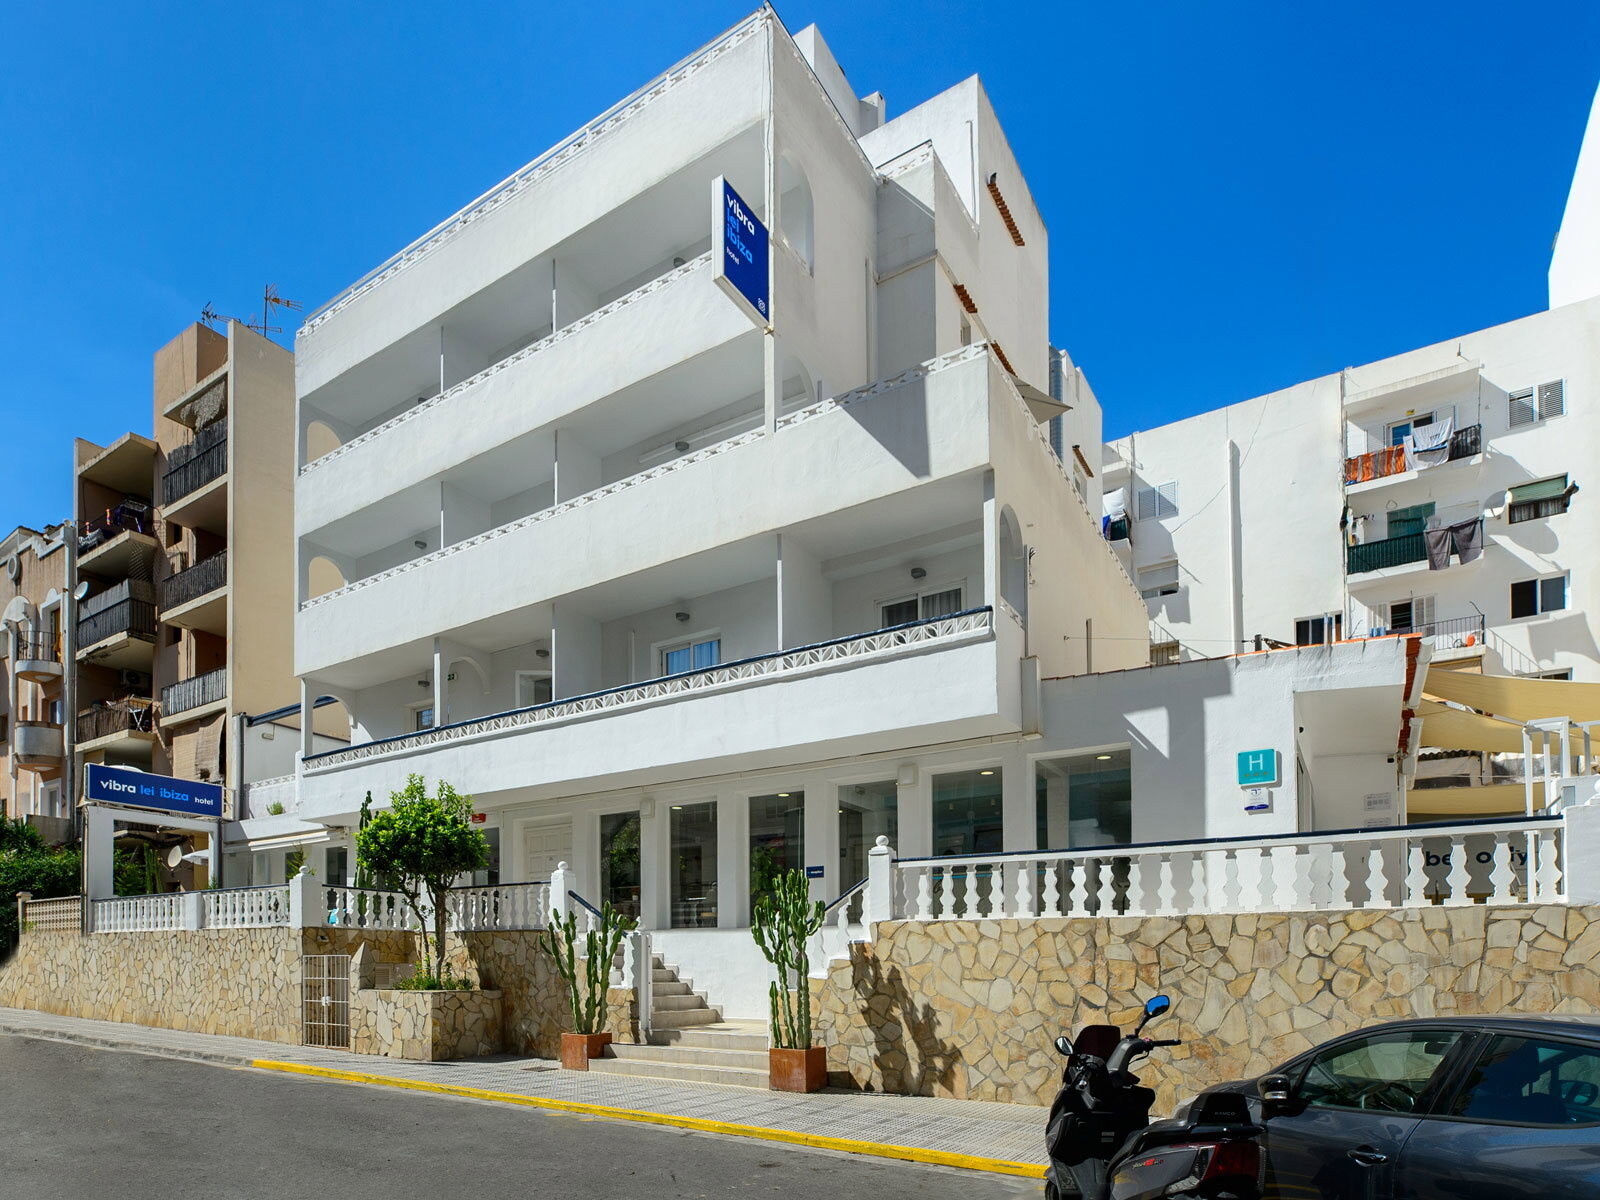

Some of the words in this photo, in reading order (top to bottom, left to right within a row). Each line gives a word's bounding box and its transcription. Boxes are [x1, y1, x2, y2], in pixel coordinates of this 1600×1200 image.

[726, 194, 755, 236] vibra
[726, 207, 740, 233] lei
[726, 223, 753, 264] ibiza
[726, 246, 740, 265] hotel
[1249, 753, 1263, 771] H
[100, 779, 136, 794] vibra
[140, 784, 155, 796] lei
[160, 787, 189, 801] ibiza
[194, 796, 214, 806] hotel
[1475, 845, 1528, 866] oly
